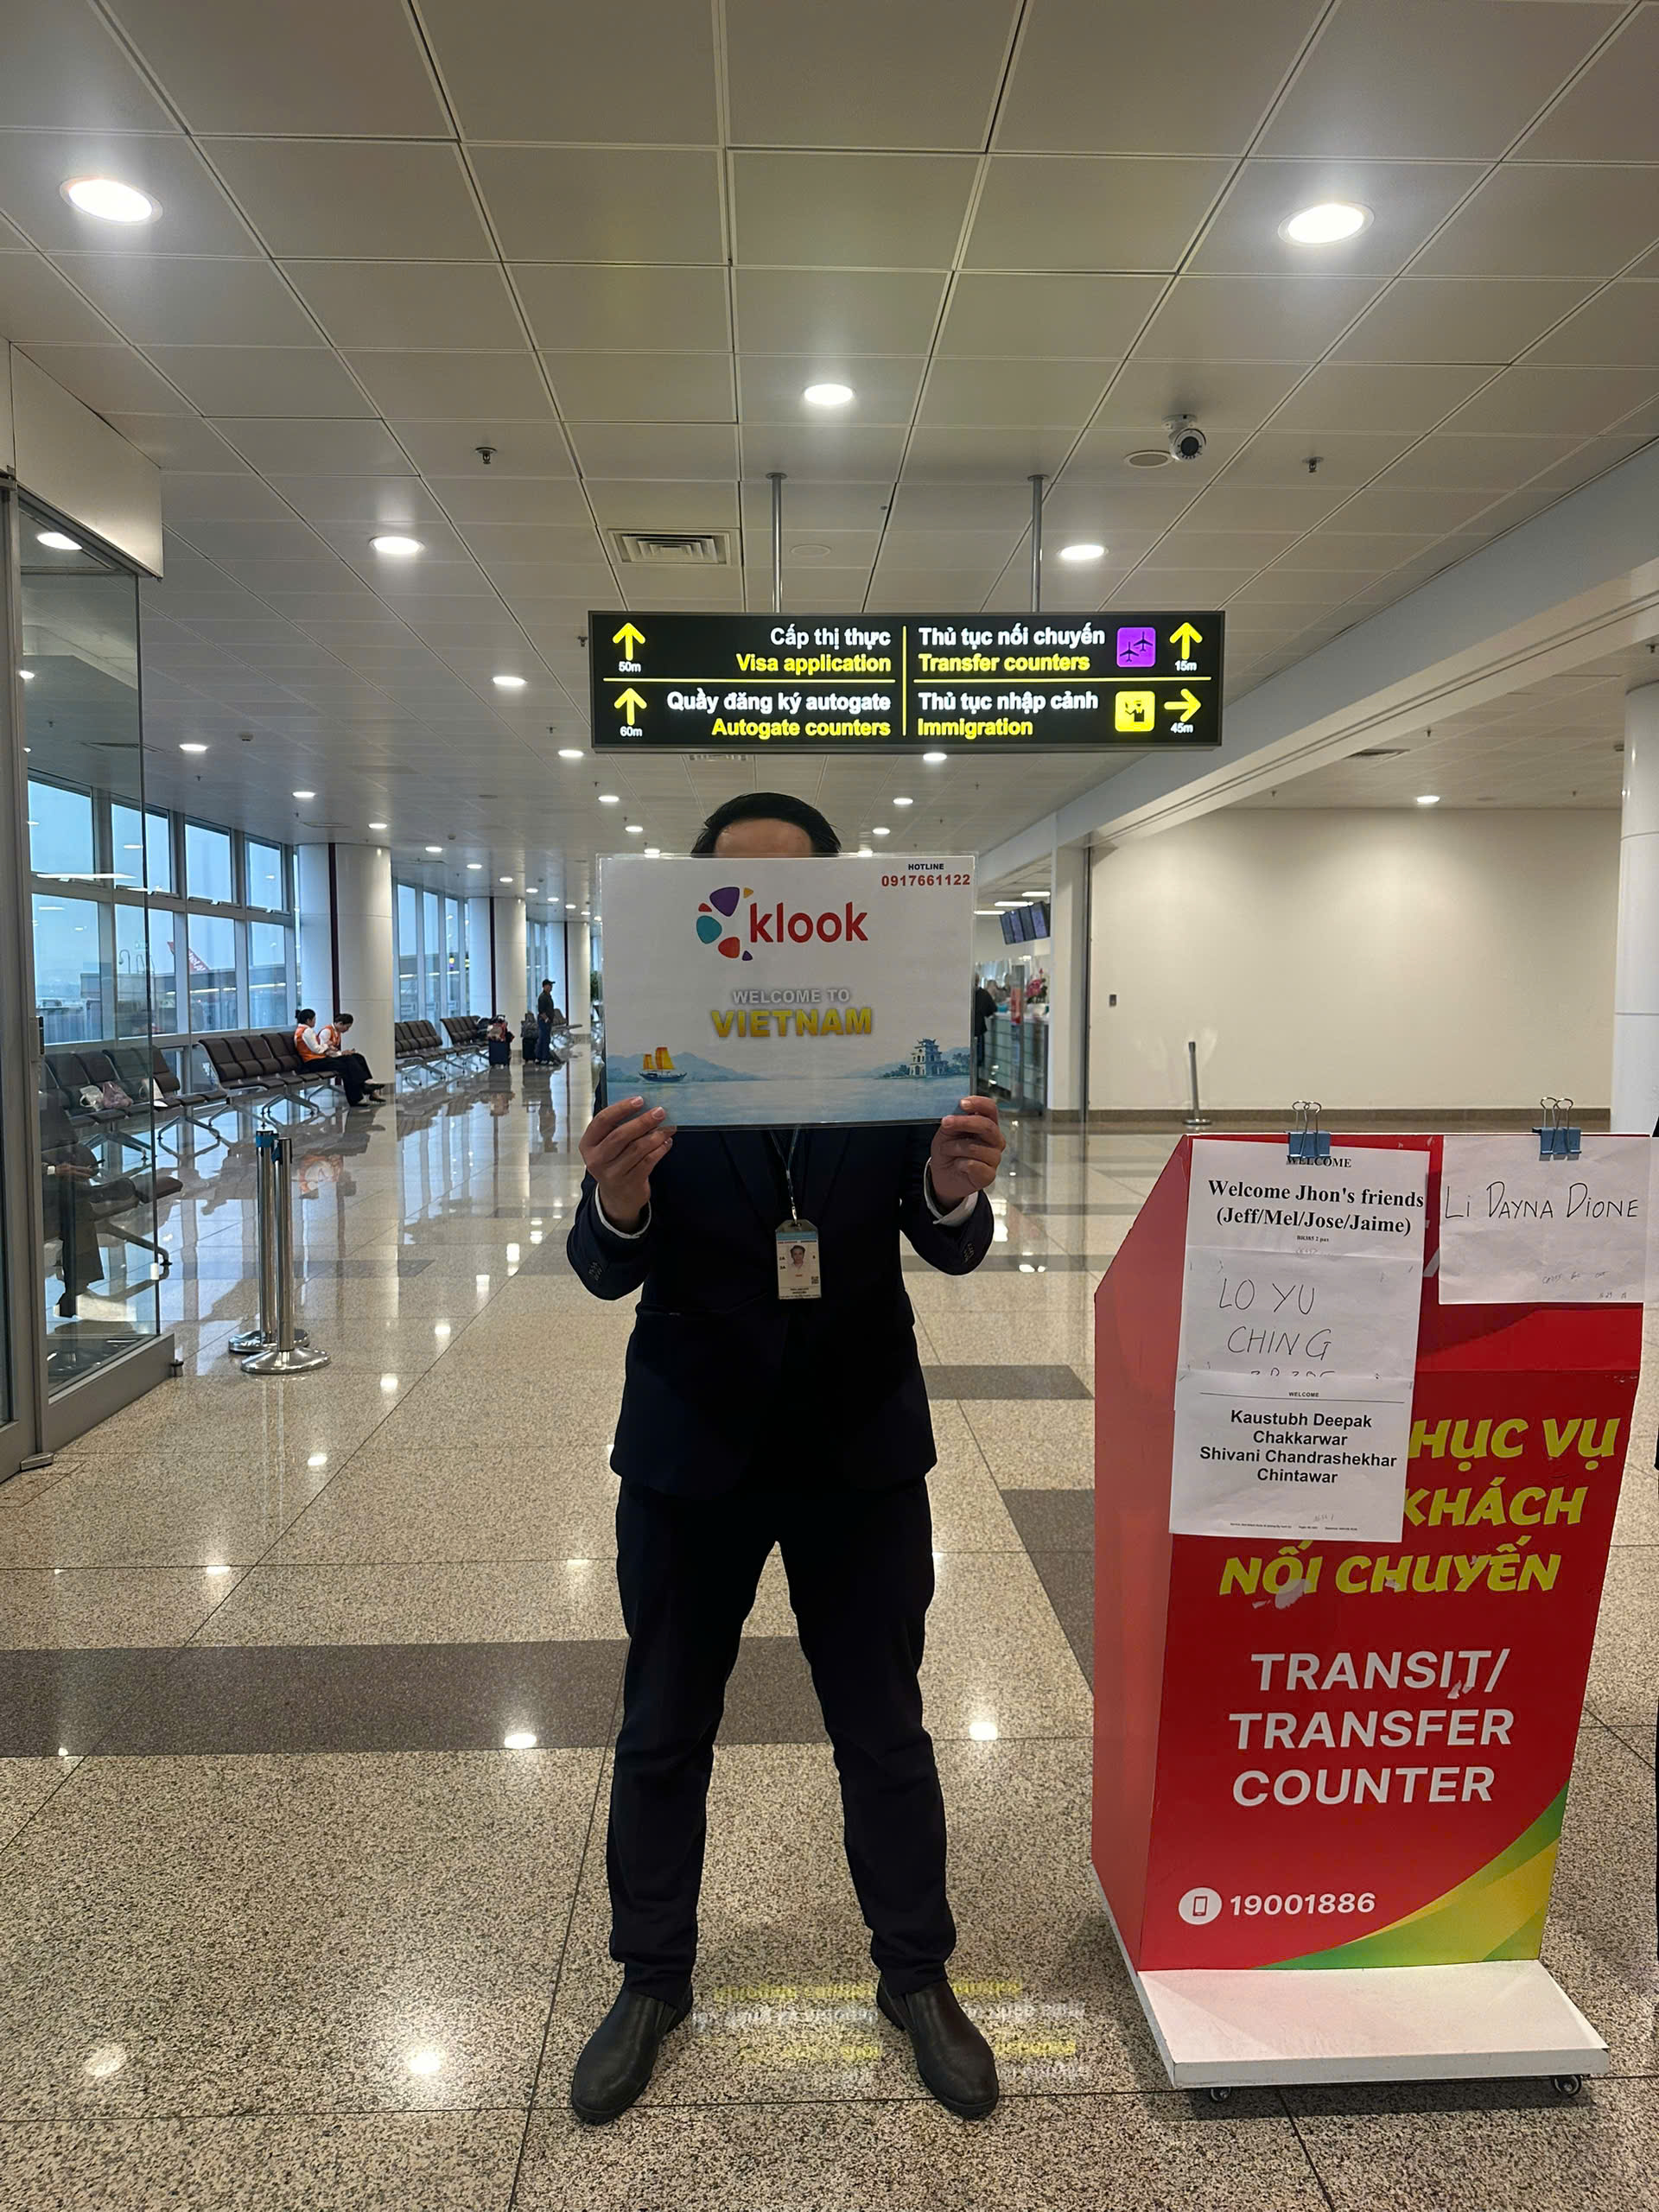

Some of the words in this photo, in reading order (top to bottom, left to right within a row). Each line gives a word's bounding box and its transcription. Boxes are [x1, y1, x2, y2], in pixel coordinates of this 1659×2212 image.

[770, 624, 810, 649] Cấp
[814, 628, 840, 649] thị
[844, 628, 891, 649] thực
[918, 626, 957, 645] Thủ
[961, 630, 993, 650] tục
[997, 622, 1028, 645] nối
[1033, 622, 1105, 648] chuyến
[618, 660, 641, 672] 50m
[736, 654, 779, 672] Visa
[784, 654, 891, 675] application
[918, 653, 1000, 672] Transfer
[1004, 654, 1090, 671] counters
[1174, 660, 1198, 672] 15m
[666, 687, 719, 714] Quầy
[723, 692, 772, 714] đăng
[778, 692, 802, 715] ký
[805, 695, 891, 715] autogate
[918, 690, 957, 710] Thủ
[960, 694, 993, 715] tục
[997, 691, 1046, 715] nhập
[1050, 691, 1098, 710] cảnh
[620, 726, 643, 737] 60m
[711, 718, 802, 740] Autogate
[804, 720, 891, 736] counters
[918, 717, 1033, 740] Immigration
[1170, 722, 1194, 734] 45m
[881, 874, 970, 887] 0917661122
[749, 901, 869, 944] klook
[732, 989, 821, 1004] WELCOME
[827, 988, 850, 1002] TO
[712, 1007, 871, 1038] VIETNAM
[1286, 1154, 1352, 1168] WELCOME
[1208, 1179, 1291, 1200] Welcome
[1294, 1185, 1355, 1204] Jhon's
[1361, 1188, 1425, 1208] friends
[1217, 1207, 1411, 1236] (Jeff/Mel/Jose/Jaime)
[1218, 1278, 1255, 1311] LO
[1272, 1282, 1316, 1316] YU
[1226, 1325, 1332, 1362] CHING
[1230, 1409, 1308, 1426] Kaustubh
[1313, 1413, 1372, 1430] Deepak
[1253, 1430, 1348, 1446] Chakkarwar
[1408, 1418, 1529, 1471] HỤC
[1541, 1417, 1621, 1471] VỤ
[1199, 1446, 1260, 1463] Shivani
[1265, 1450, 1397, 1467] Chandrashekhar
[1256, 1468, 1338, 1484] Chintawar
[1219, 1541, 1323, 1595] NỐI
[1335, 1535, 1562, 1594] CHUYẾN
[1250, 1649, 1510, 1692] TRANSIT/
[1229, 1709, 1515, 1750] TRANSFER
[1232, 1767, 1495, 1807] COUNTER
[1230, 1892, 1377, 1916] 19001886
